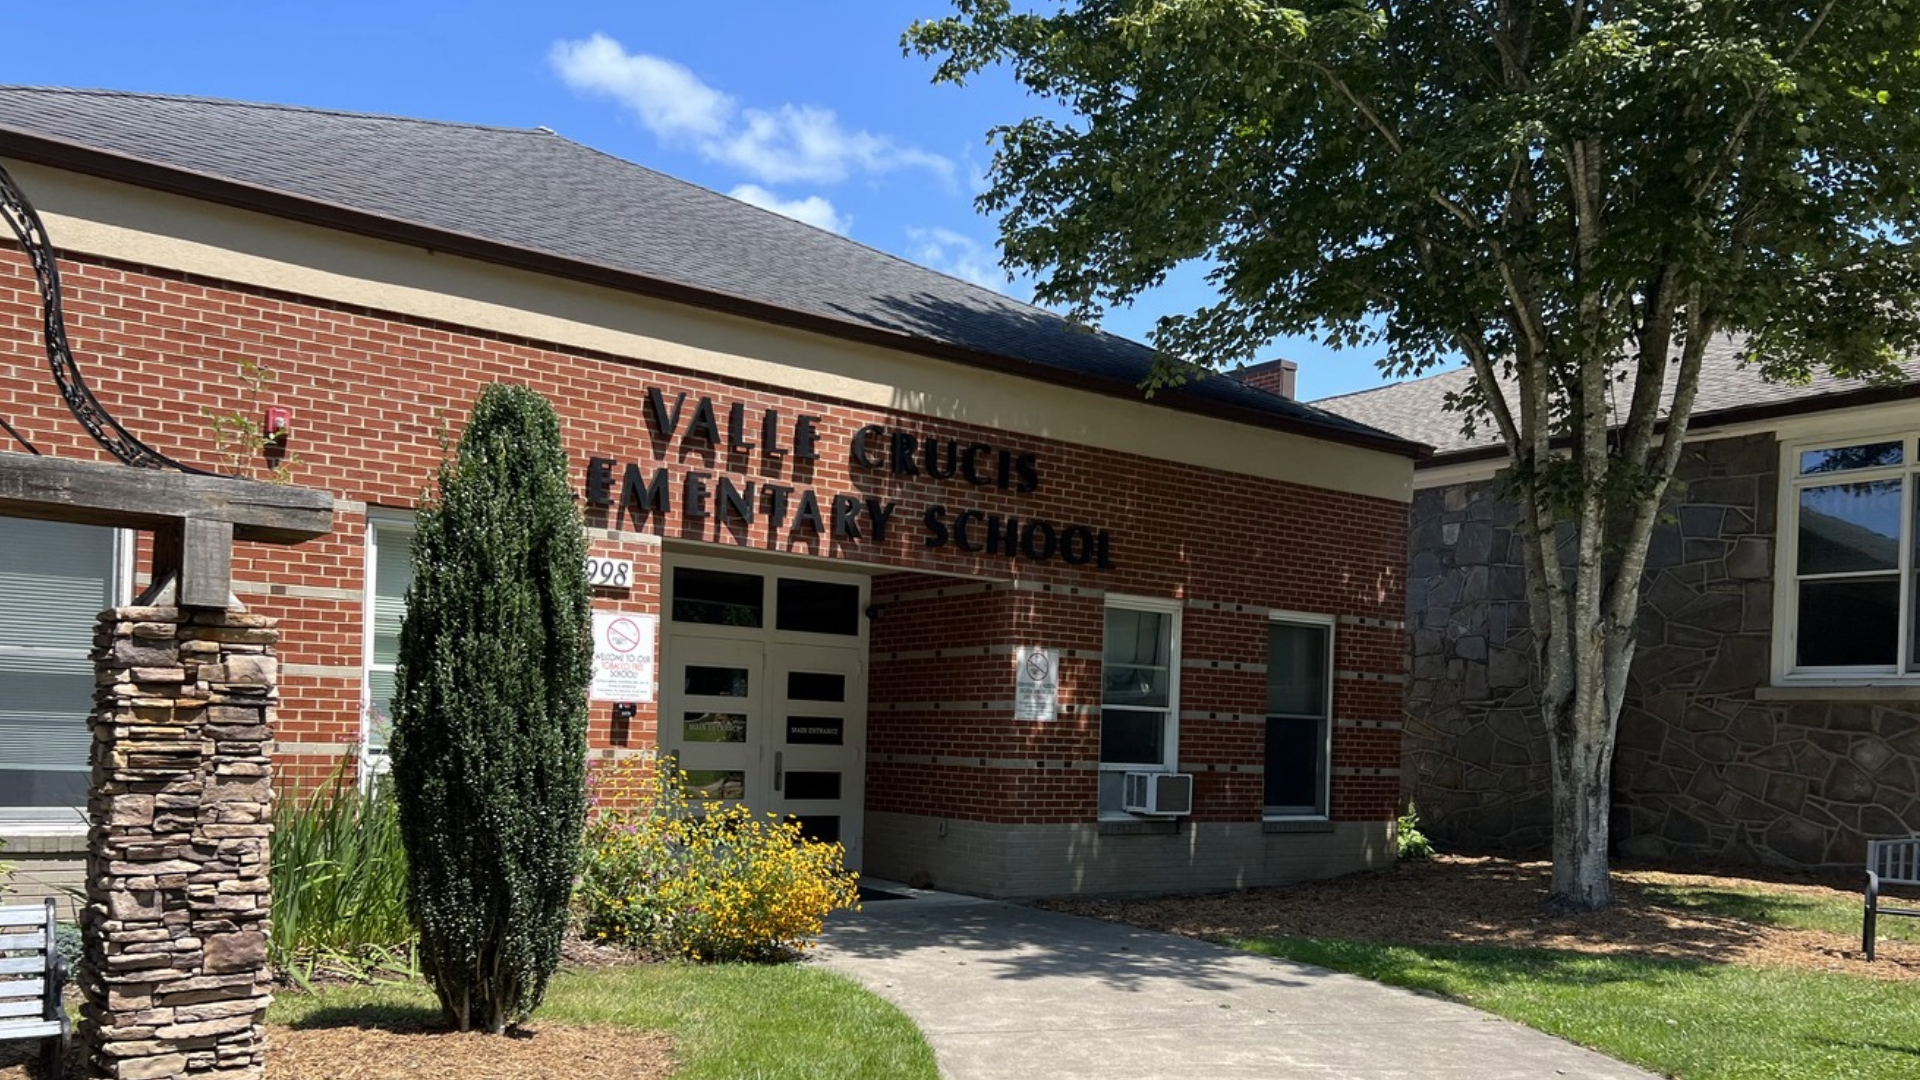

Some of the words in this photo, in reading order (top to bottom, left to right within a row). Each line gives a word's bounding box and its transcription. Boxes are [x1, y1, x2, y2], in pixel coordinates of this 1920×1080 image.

[644, 386, 821, 460] VALLE
[849, 423, 1039, 493] CRUCIS
[574, 456, 897, 543] EMENTARY
[923, 504, 1116, 569] SCHOOL
[595, 653, 624, 662] WELCOME
[626, 654, 635, 662] TO
[637, 655, 651, 663] OUR
[602, 661, 630, 670] TOBACCO
[632, 662, 645, 671] FREE
[689, 722, 706, 731] MAIN
[791, 726, 807, 735] MAIN
[808, 726, 839, 735] ENTRANCE
